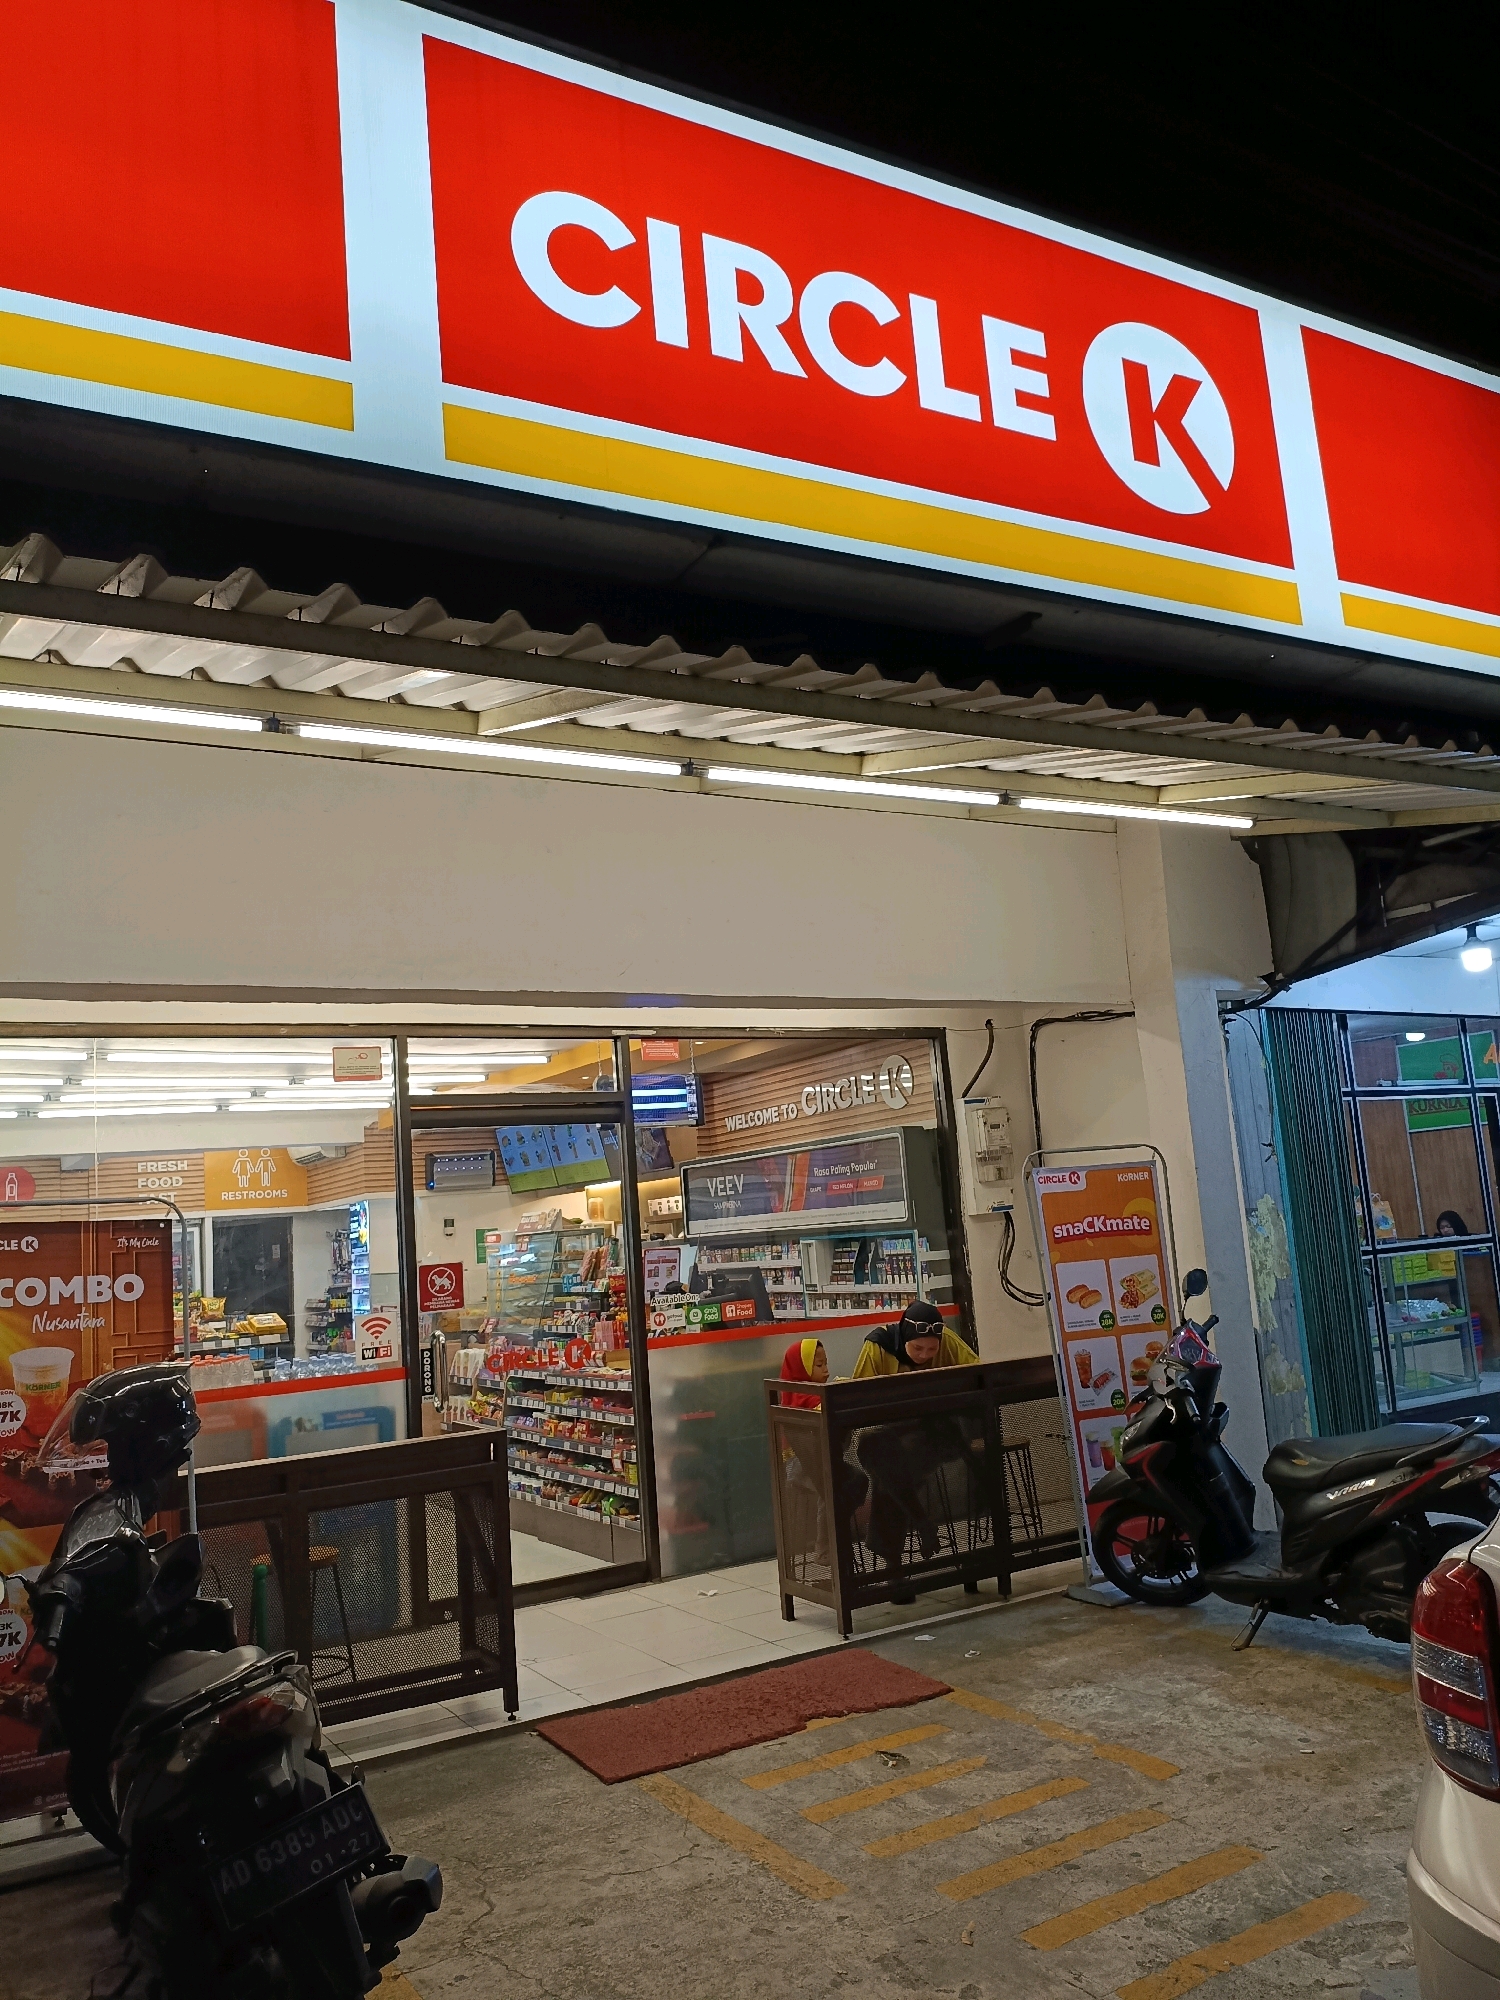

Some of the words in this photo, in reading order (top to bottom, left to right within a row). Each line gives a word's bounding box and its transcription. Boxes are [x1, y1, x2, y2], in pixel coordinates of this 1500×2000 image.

[511, 191, 1057, 442] CIRCLE
[1083, 322, 1235, 515] K
[1483, 1043, 1500, 1064] A
[724, 1106, 780, 1132] WELCOME
[781, 1103, 798, 1120] TO
[801, 1072, 877, 1116] CIRCLE
[879, 1054, 914, 1109] K
[137, 1160, 188, 1173] FRESH
[137, 1176, 183, 1189] FOOD
[706, 1174, 744, 1198] VEEV
[1038, 1174, 1067, 1184] CIRCLE
[1068, 1171, 1081, 1185] K
[1117, 1171, 1149, 1182] KÖRNER
[221, 1189, 288, 1201] RESTROOMS
[1053, 1215, 1150, 1238] snaCKmate
[21, 1236, 39, 1253] K
[117, 1236, 128, 1248] It's
[129, 1238, 141, 1248] My
[141, 1237, 160, 1248] Circle
[0, 1273, 145, 1308] COMBO
[32, 1306, 105, 1334] Nusantara
[736, 1308, 753, 1316] Food
[486, 1347, 560, 1373] CIRCLE
[564, 1337, 592, 1369] K
[423, 1351, 432, 1393] DORONG
[25, 1381, 62, 1392] KÖRNER
[1113, 1397, 1126, 1406] 20K
[220, 1859, 252, 1895] AD
[255, 1827, 317, 1873] 6385
[320, 1797, 364, 1840] ADC
